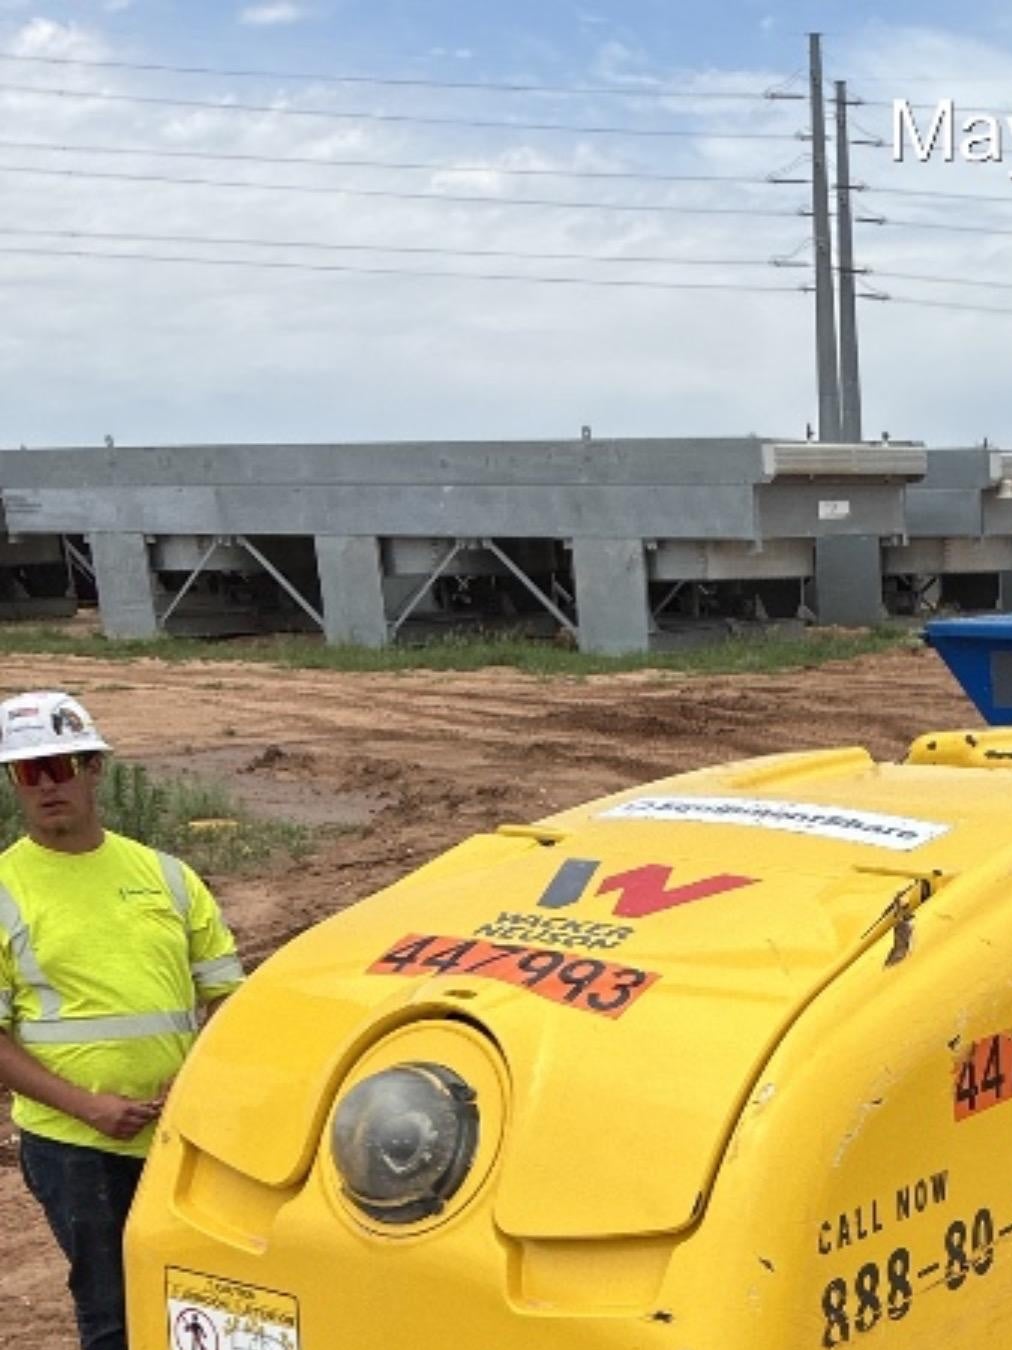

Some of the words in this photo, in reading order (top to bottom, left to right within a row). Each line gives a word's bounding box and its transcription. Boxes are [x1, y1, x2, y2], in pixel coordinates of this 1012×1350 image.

[496, 911, 634, 940] WACKER
[379, 935, 647, 1011] 447993
[817, 1199, 883, 1255] CALL
[895, 1169, 949, 1221] NOW
